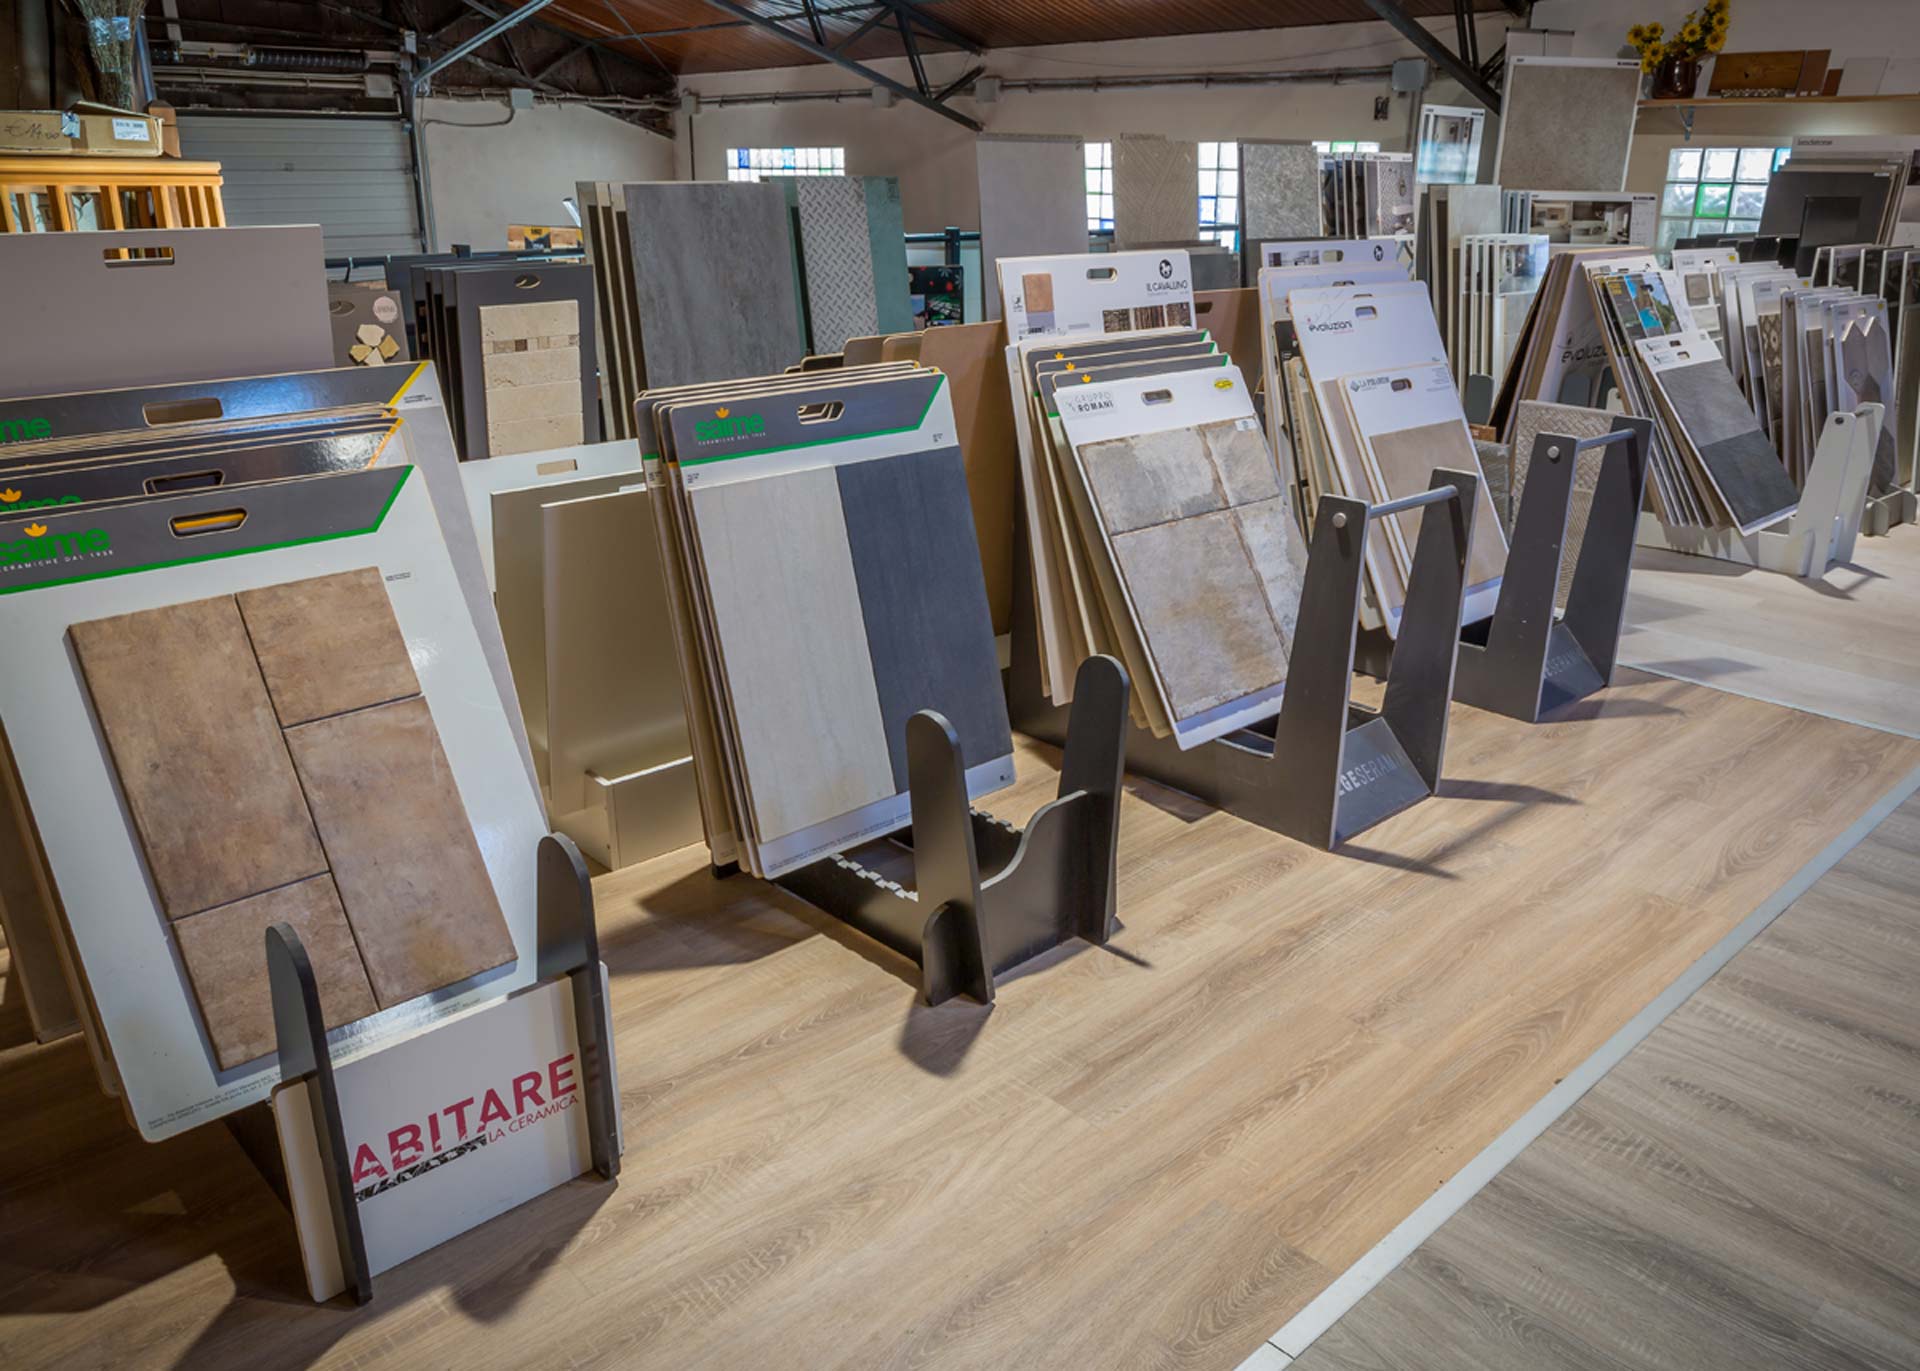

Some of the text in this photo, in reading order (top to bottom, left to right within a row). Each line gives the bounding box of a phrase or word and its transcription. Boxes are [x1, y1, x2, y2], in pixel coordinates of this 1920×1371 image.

[1561, 345, 1607, 363] evoluz
[1075, 390, 1111, 403] GRUPPO
[1078, 400, 1114, 413] ROMANI
[695, 414, 765, 441] saime
[0, 557, 58, 574] ERAMICHE
[352, 1053, 577, 1184] ABITARE
[489, 1093, 579, 1144] LA CERAMICA
